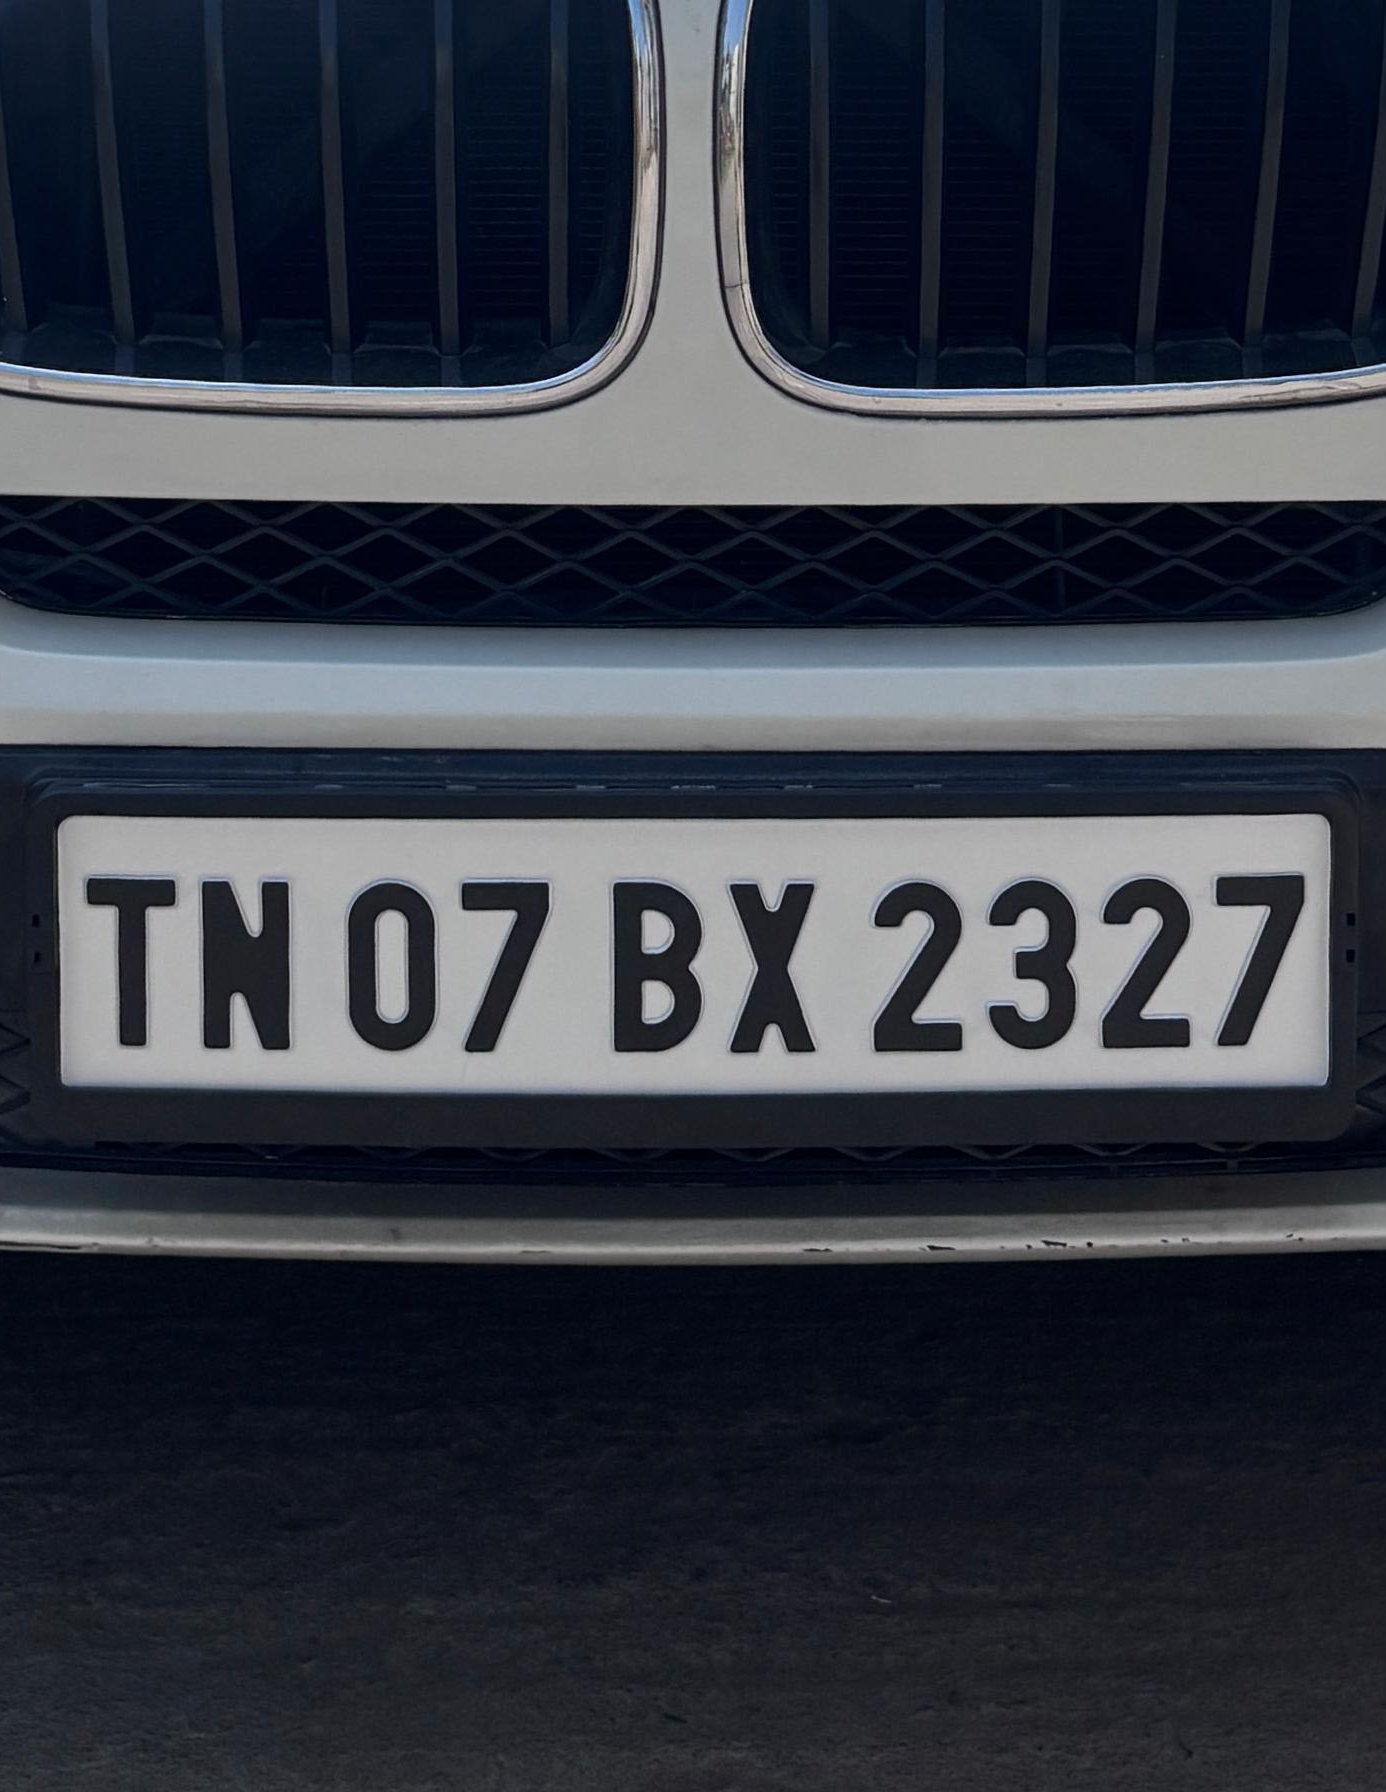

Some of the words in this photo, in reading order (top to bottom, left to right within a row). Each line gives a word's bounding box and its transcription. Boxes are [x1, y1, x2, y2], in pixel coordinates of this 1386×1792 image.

[84, 877, 292, 1051] TN
[346, 881, 551, 1054] 07
[611, 881, 817, 1054] BX
[872, 874, 1307, 1053] 2327
